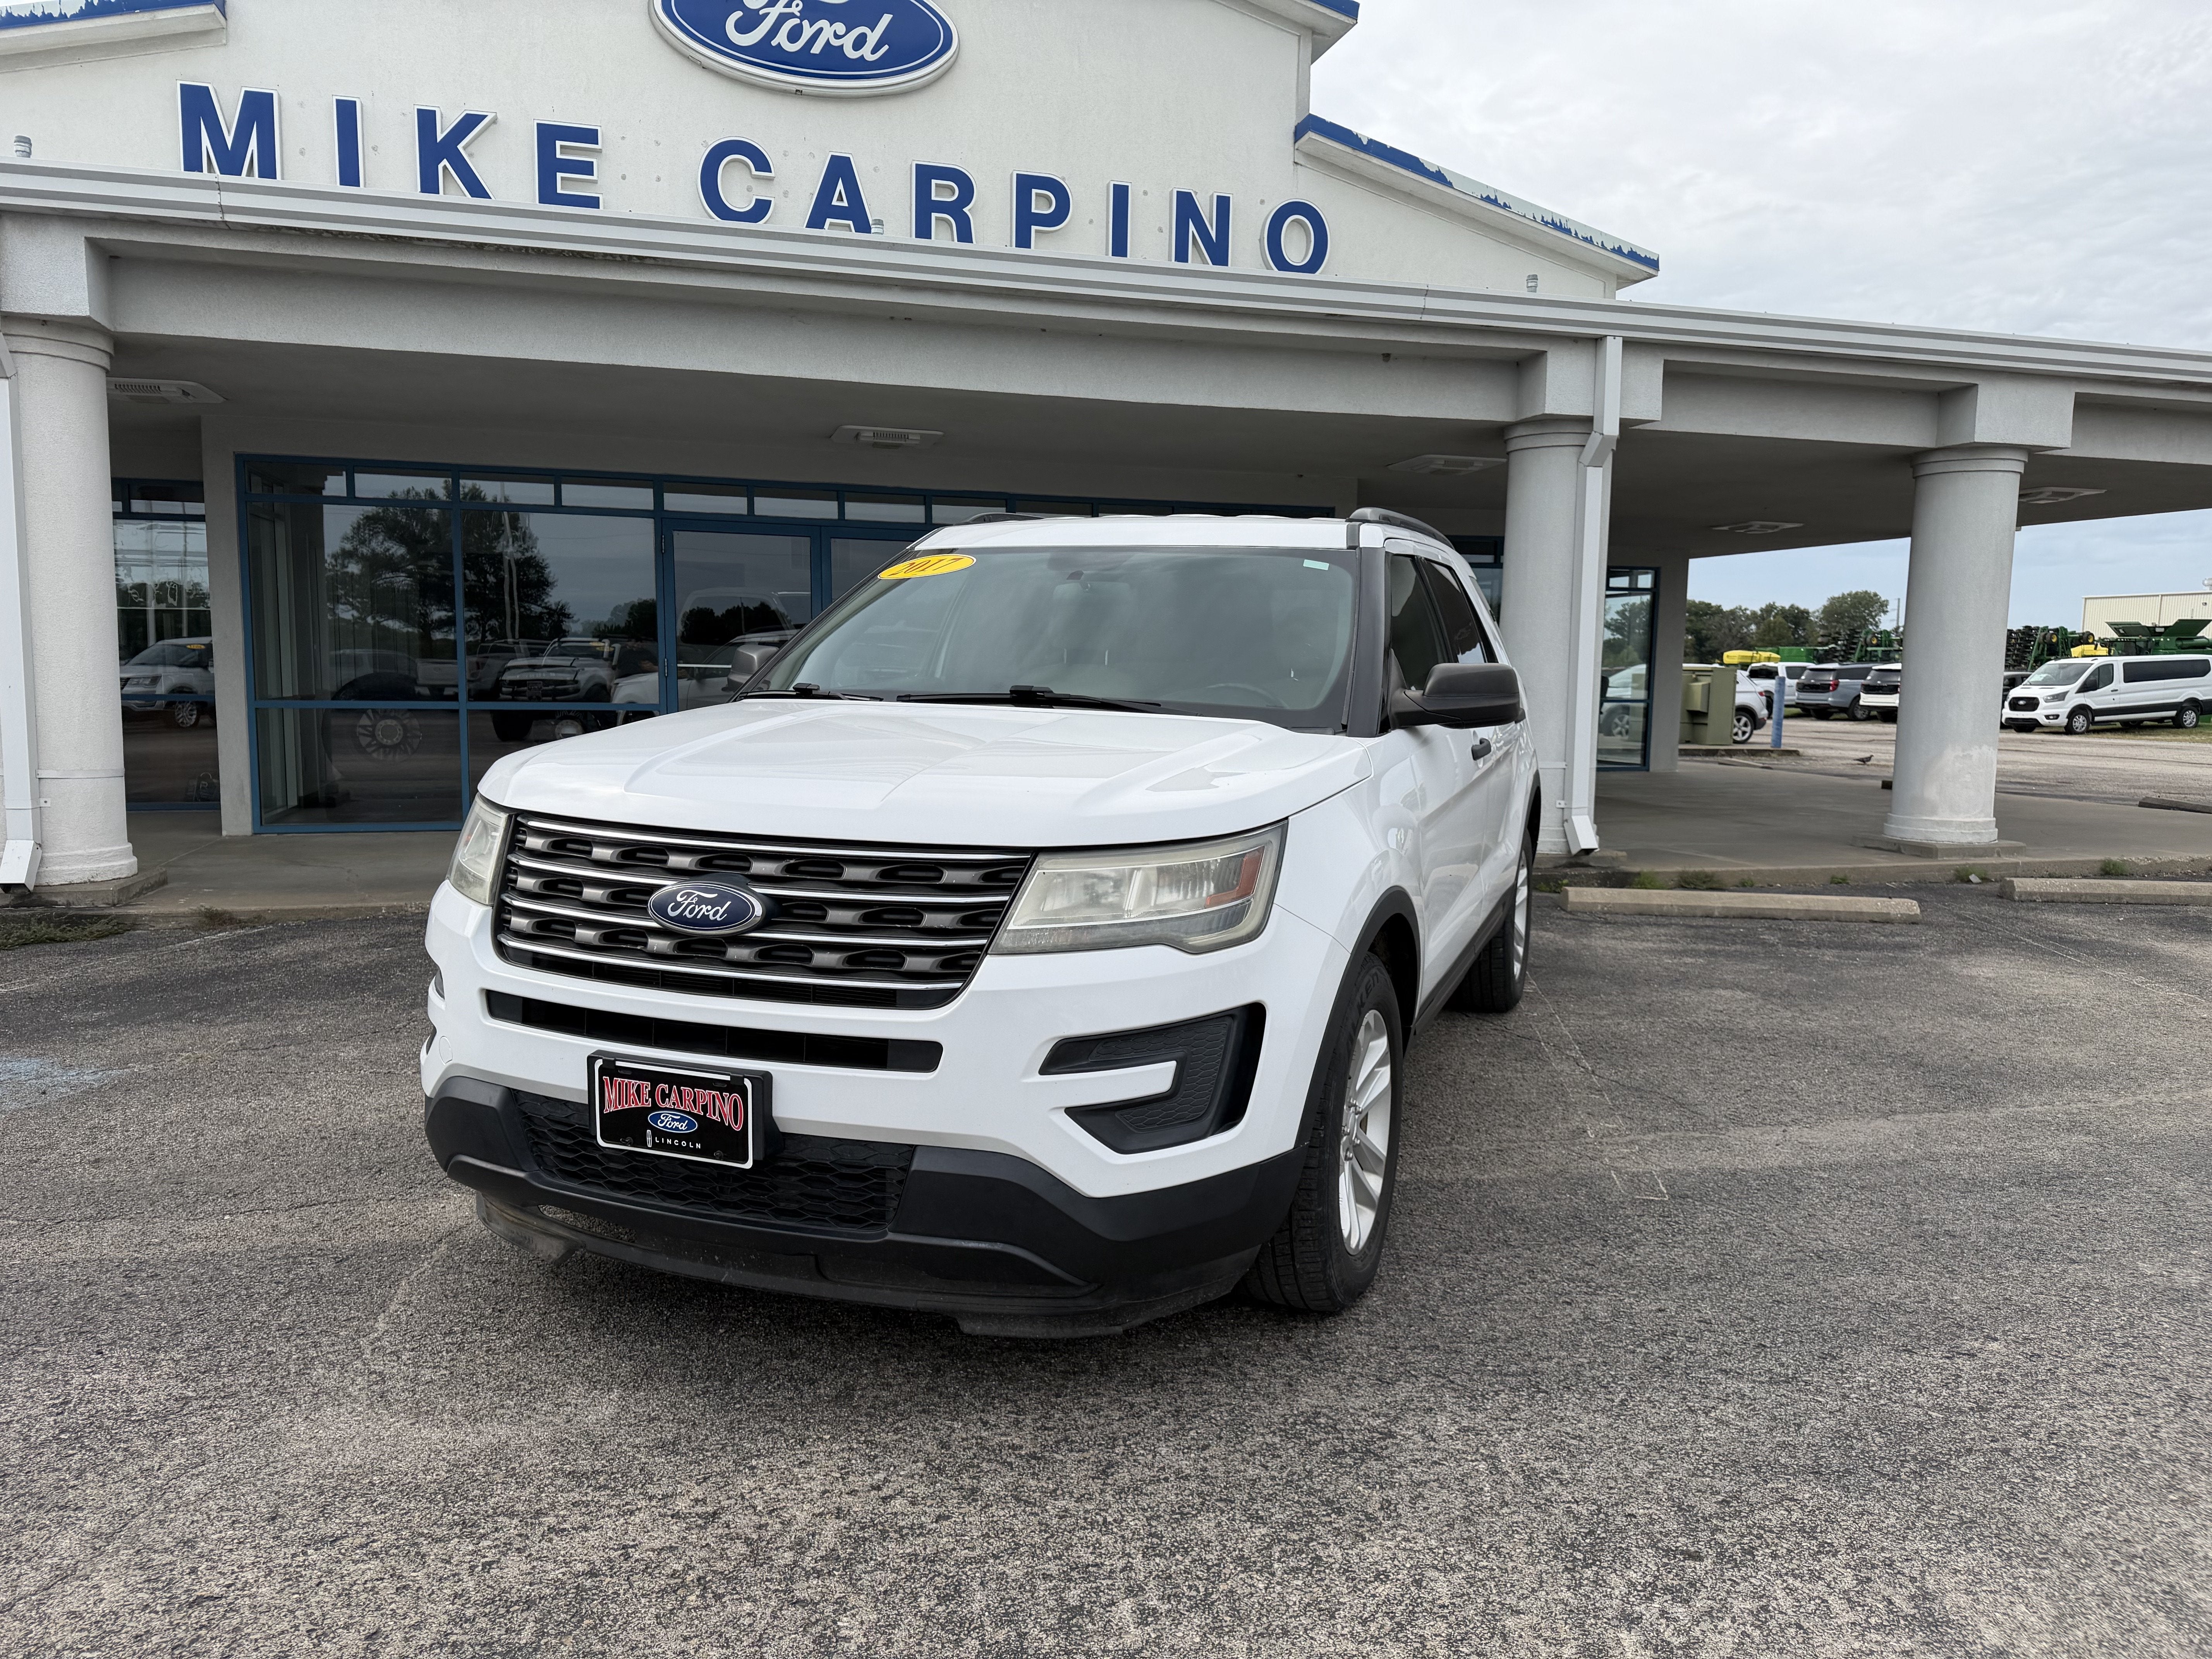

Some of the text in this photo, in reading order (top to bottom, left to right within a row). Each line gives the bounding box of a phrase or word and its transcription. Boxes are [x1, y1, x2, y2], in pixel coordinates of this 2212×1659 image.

[725, 0, 893, 61] Ford
[176, 79, 1331, 274] MIKE CARPINO
[887, 558, 965, 577] 2017
[667, 890, 732, 921] Ford
[603, 1076, 744, 1131] MIKE CARPINO
[657, 1113, 688, 1131] Ford
[655, 1137, 701, 1149] LINCOLN
